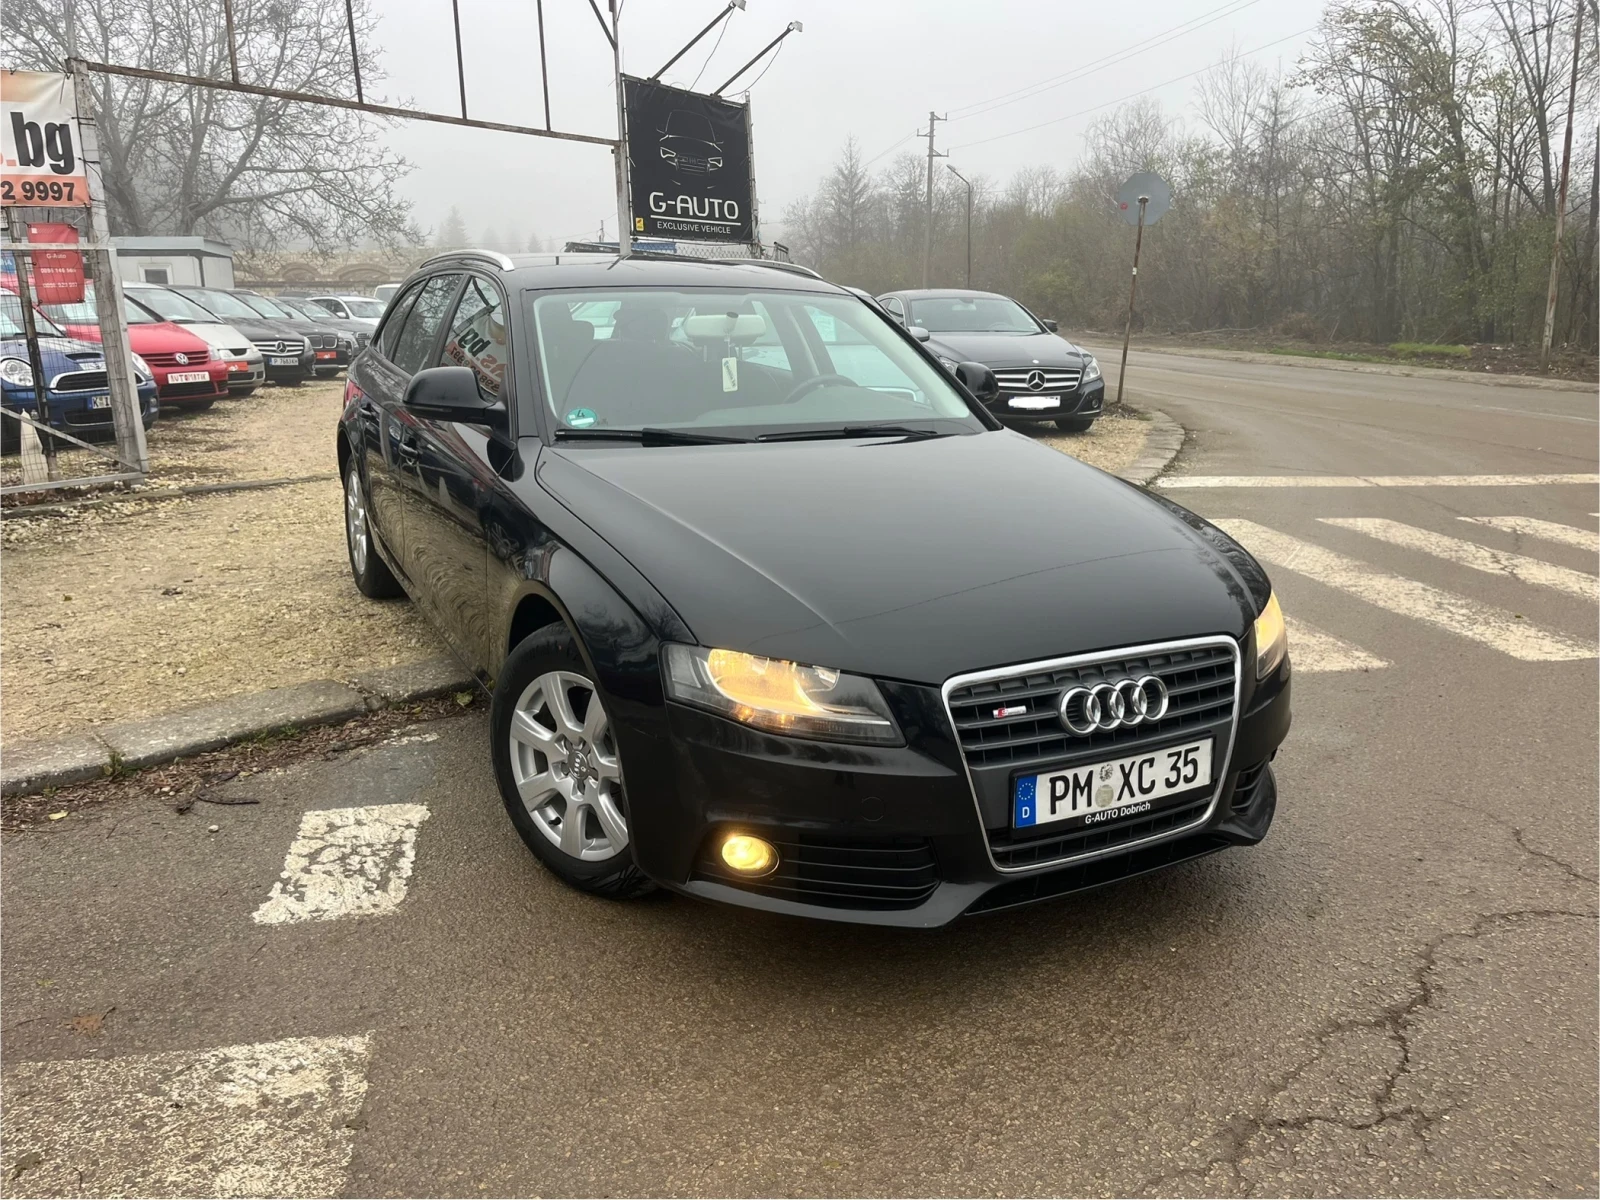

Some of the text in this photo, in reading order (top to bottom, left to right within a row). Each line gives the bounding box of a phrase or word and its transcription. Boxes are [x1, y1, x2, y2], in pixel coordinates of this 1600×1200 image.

[1, 112, 75, 175] .bg
[21, 181, 75, 201] 9997
[649, 191, 739, 219] G-AUTO
[657, 221, 700, 233] EXCLUSIVE
[701, 224, 731, 234] VEHICLE
[1049, 746, 1201, 815] PM XC 35
[1021, 806, 1031, 819] D
[1084, 801, 1151, 824] G-AUTO Dobrich
